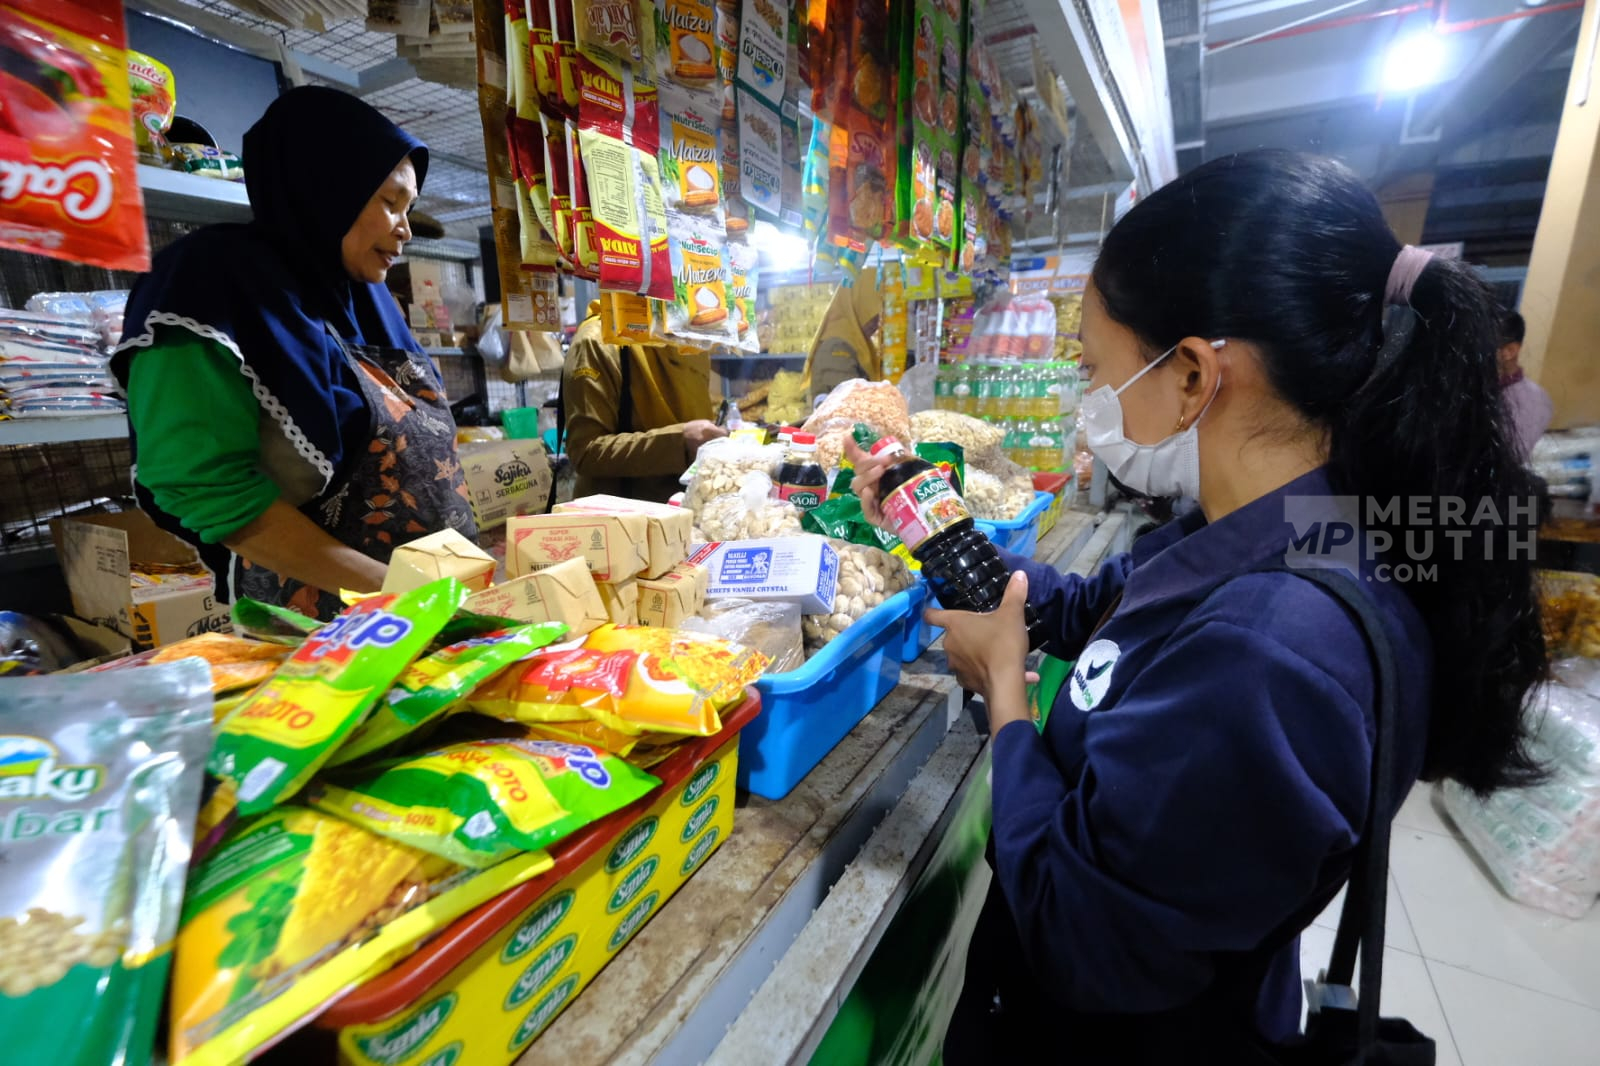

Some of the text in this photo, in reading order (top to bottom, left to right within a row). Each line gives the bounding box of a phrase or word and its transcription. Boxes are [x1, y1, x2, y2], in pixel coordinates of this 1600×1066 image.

[581, 70, 621, 98] AIDA
[600, 237, 638, 257] AIDA
[494, 464, 532, 486] Sajiku
[917, 480, 949, 500] SAORI
[790, 496, 818, 506] SAORI
[756, 585, 788, 593] CRYSTAL
[688, 768, 714, 798] Sania
[688, 800, 714, 835] Sania
[615, 826, 651, 865] Sania
[687, 835, 714, 869] Sania
[616, 867, 651, 905] Sania
[514, 900, 563, 953] Sania
[617, 902, 651, 939] Sania
[517, 943, 566, 998] Sania
[521, 984, 569, 1039] Sania
[368, 1005, 441, 1065] Sania
